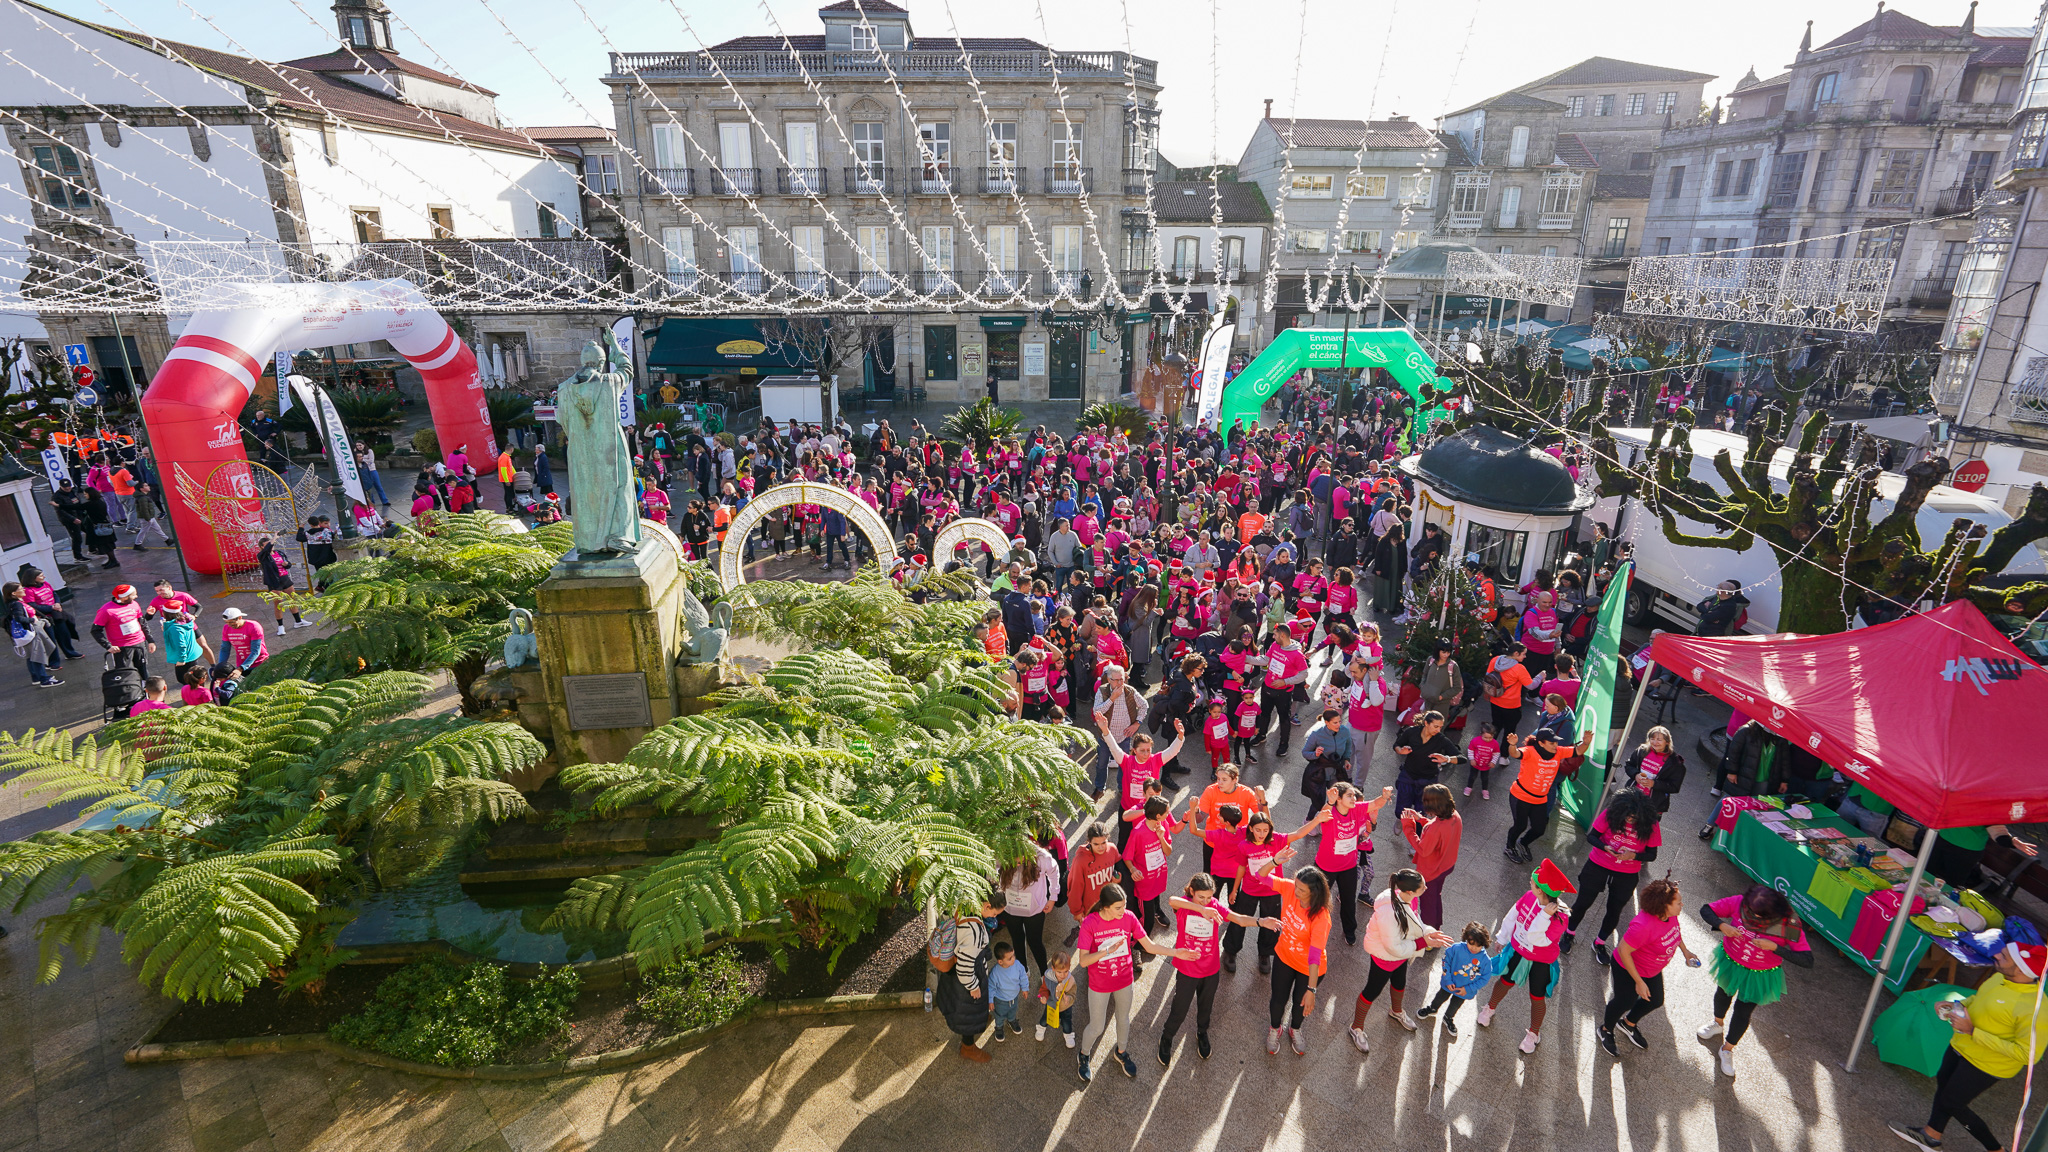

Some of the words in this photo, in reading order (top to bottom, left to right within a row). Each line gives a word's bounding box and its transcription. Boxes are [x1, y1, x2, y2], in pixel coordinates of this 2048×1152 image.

[1309, 342, 1338, 350] contra
[1308, 351, 1318, 359] el
[1957, 473, 1986, 483] STOP
